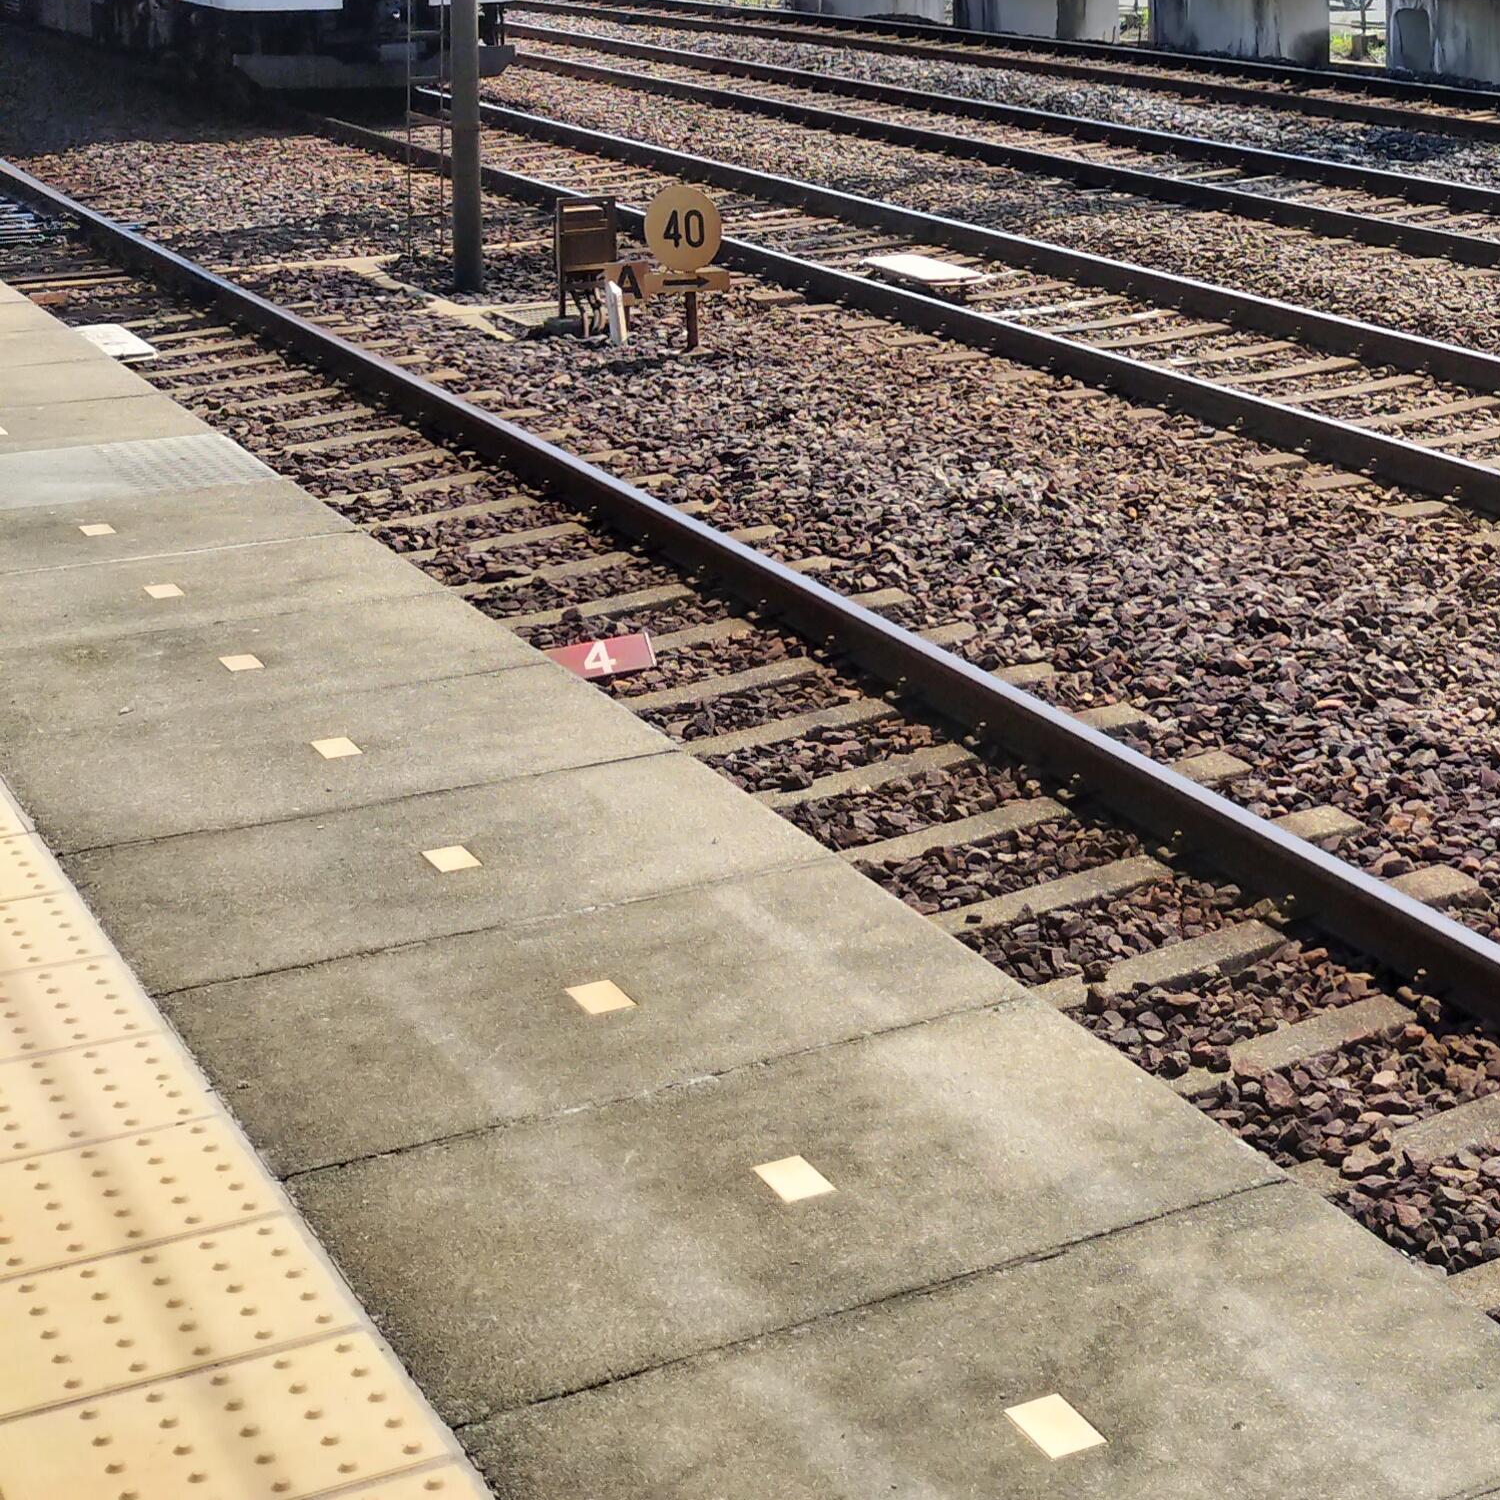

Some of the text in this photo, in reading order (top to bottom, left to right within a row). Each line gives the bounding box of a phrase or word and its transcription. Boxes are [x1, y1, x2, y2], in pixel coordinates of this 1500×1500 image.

[663, 209, 705, 248] 40
[617, 264, 643, 299] A
[584, 640, 617, 674] 4
